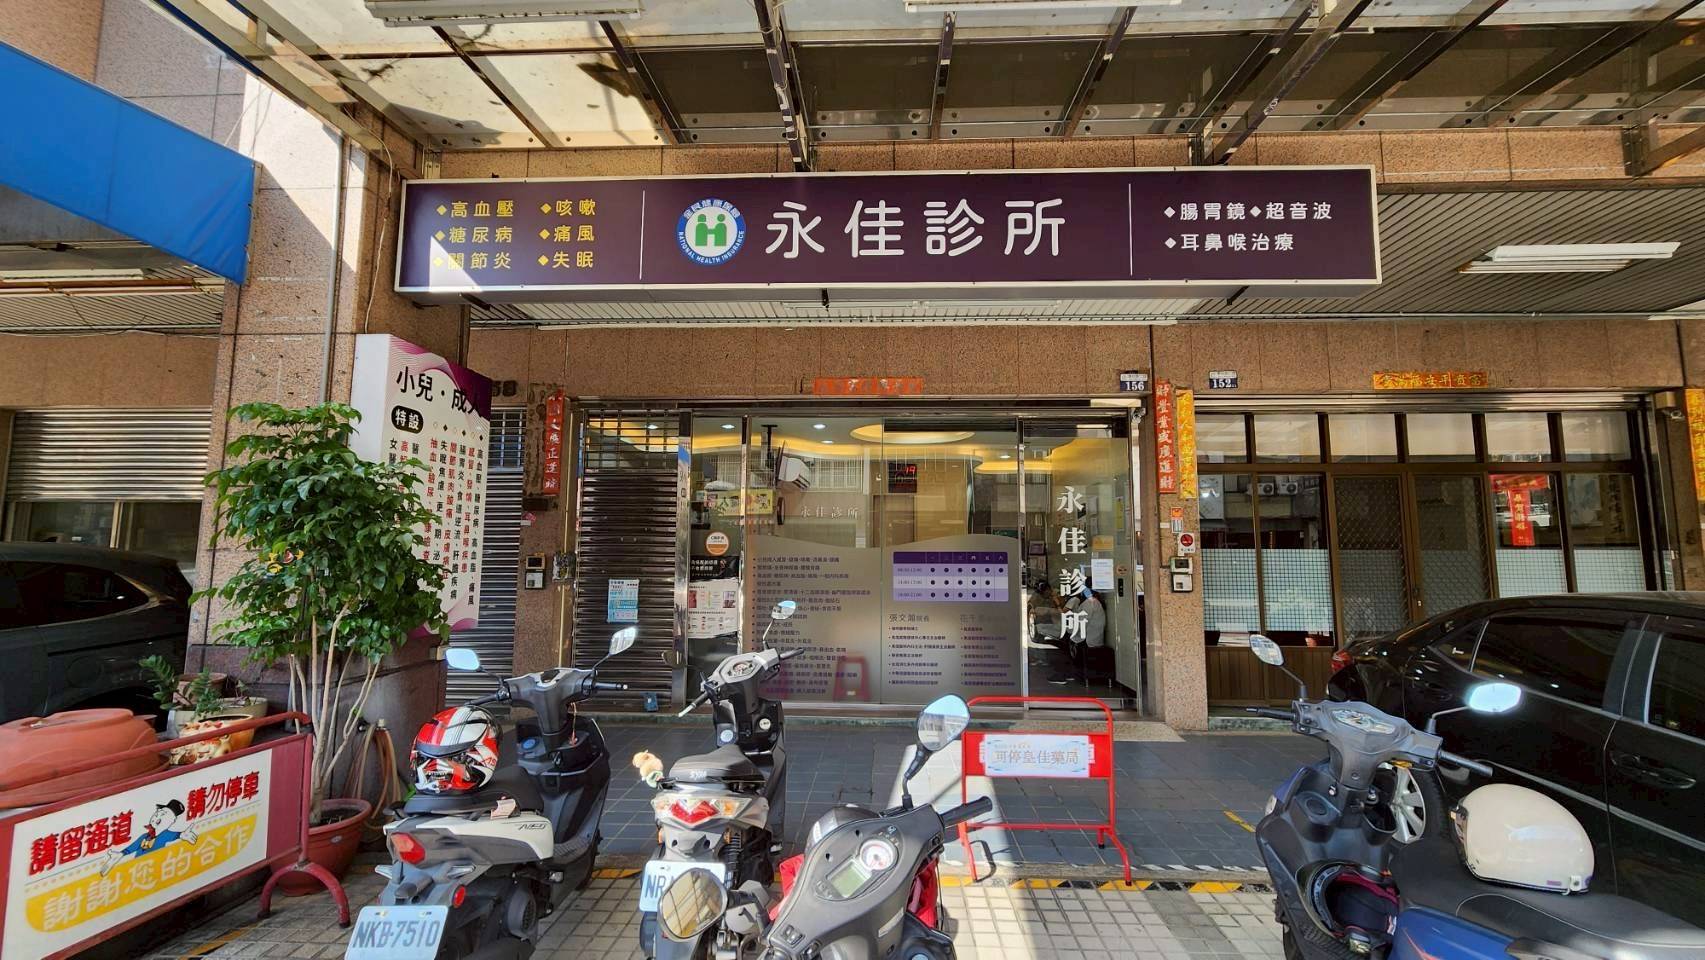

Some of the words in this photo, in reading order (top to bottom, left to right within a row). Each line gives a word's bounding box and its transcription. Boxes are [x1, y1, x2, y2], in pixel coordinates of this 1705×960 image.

[450, 199, 514, 218] 高血壓
[555, 198, 596, 217] 咳嗽
[1180, 202, 1246, 221] 腸胃鏡
[1265, 201, 1333, 220] 超音波
[448, 225, 513, 244] 糖尿病
[553, 224, 595, 243] 痛風
[765, 197, 1066, 259] 永佳診所
[678, 231, 696, 259] NATIONAL
[696, 256, 721, 264] HEALTH
[721, 230, 745, 261] INSURANCE
[1180, 233, 1295, 252] 耳鼻喉治療
[446, 251, 512, 270] 關節炎
[552, 250, 594, 269] 失眠
[1125, 381, 1145, 391] 156
[1212, 378, 1232, 388] 152
[395, 408, 419, 430] 特設
[800, 505, 859, 520] 永佳診所
[1056, 485, 1089, 641] 永佳診所
[186, 771, 260, 821] 請勿停車
[28, 809, 134, 876] 請留通道
[42, 824, 252, 932] 謝謝您的合作
[352, 919, 441, 948] NKB-7510
